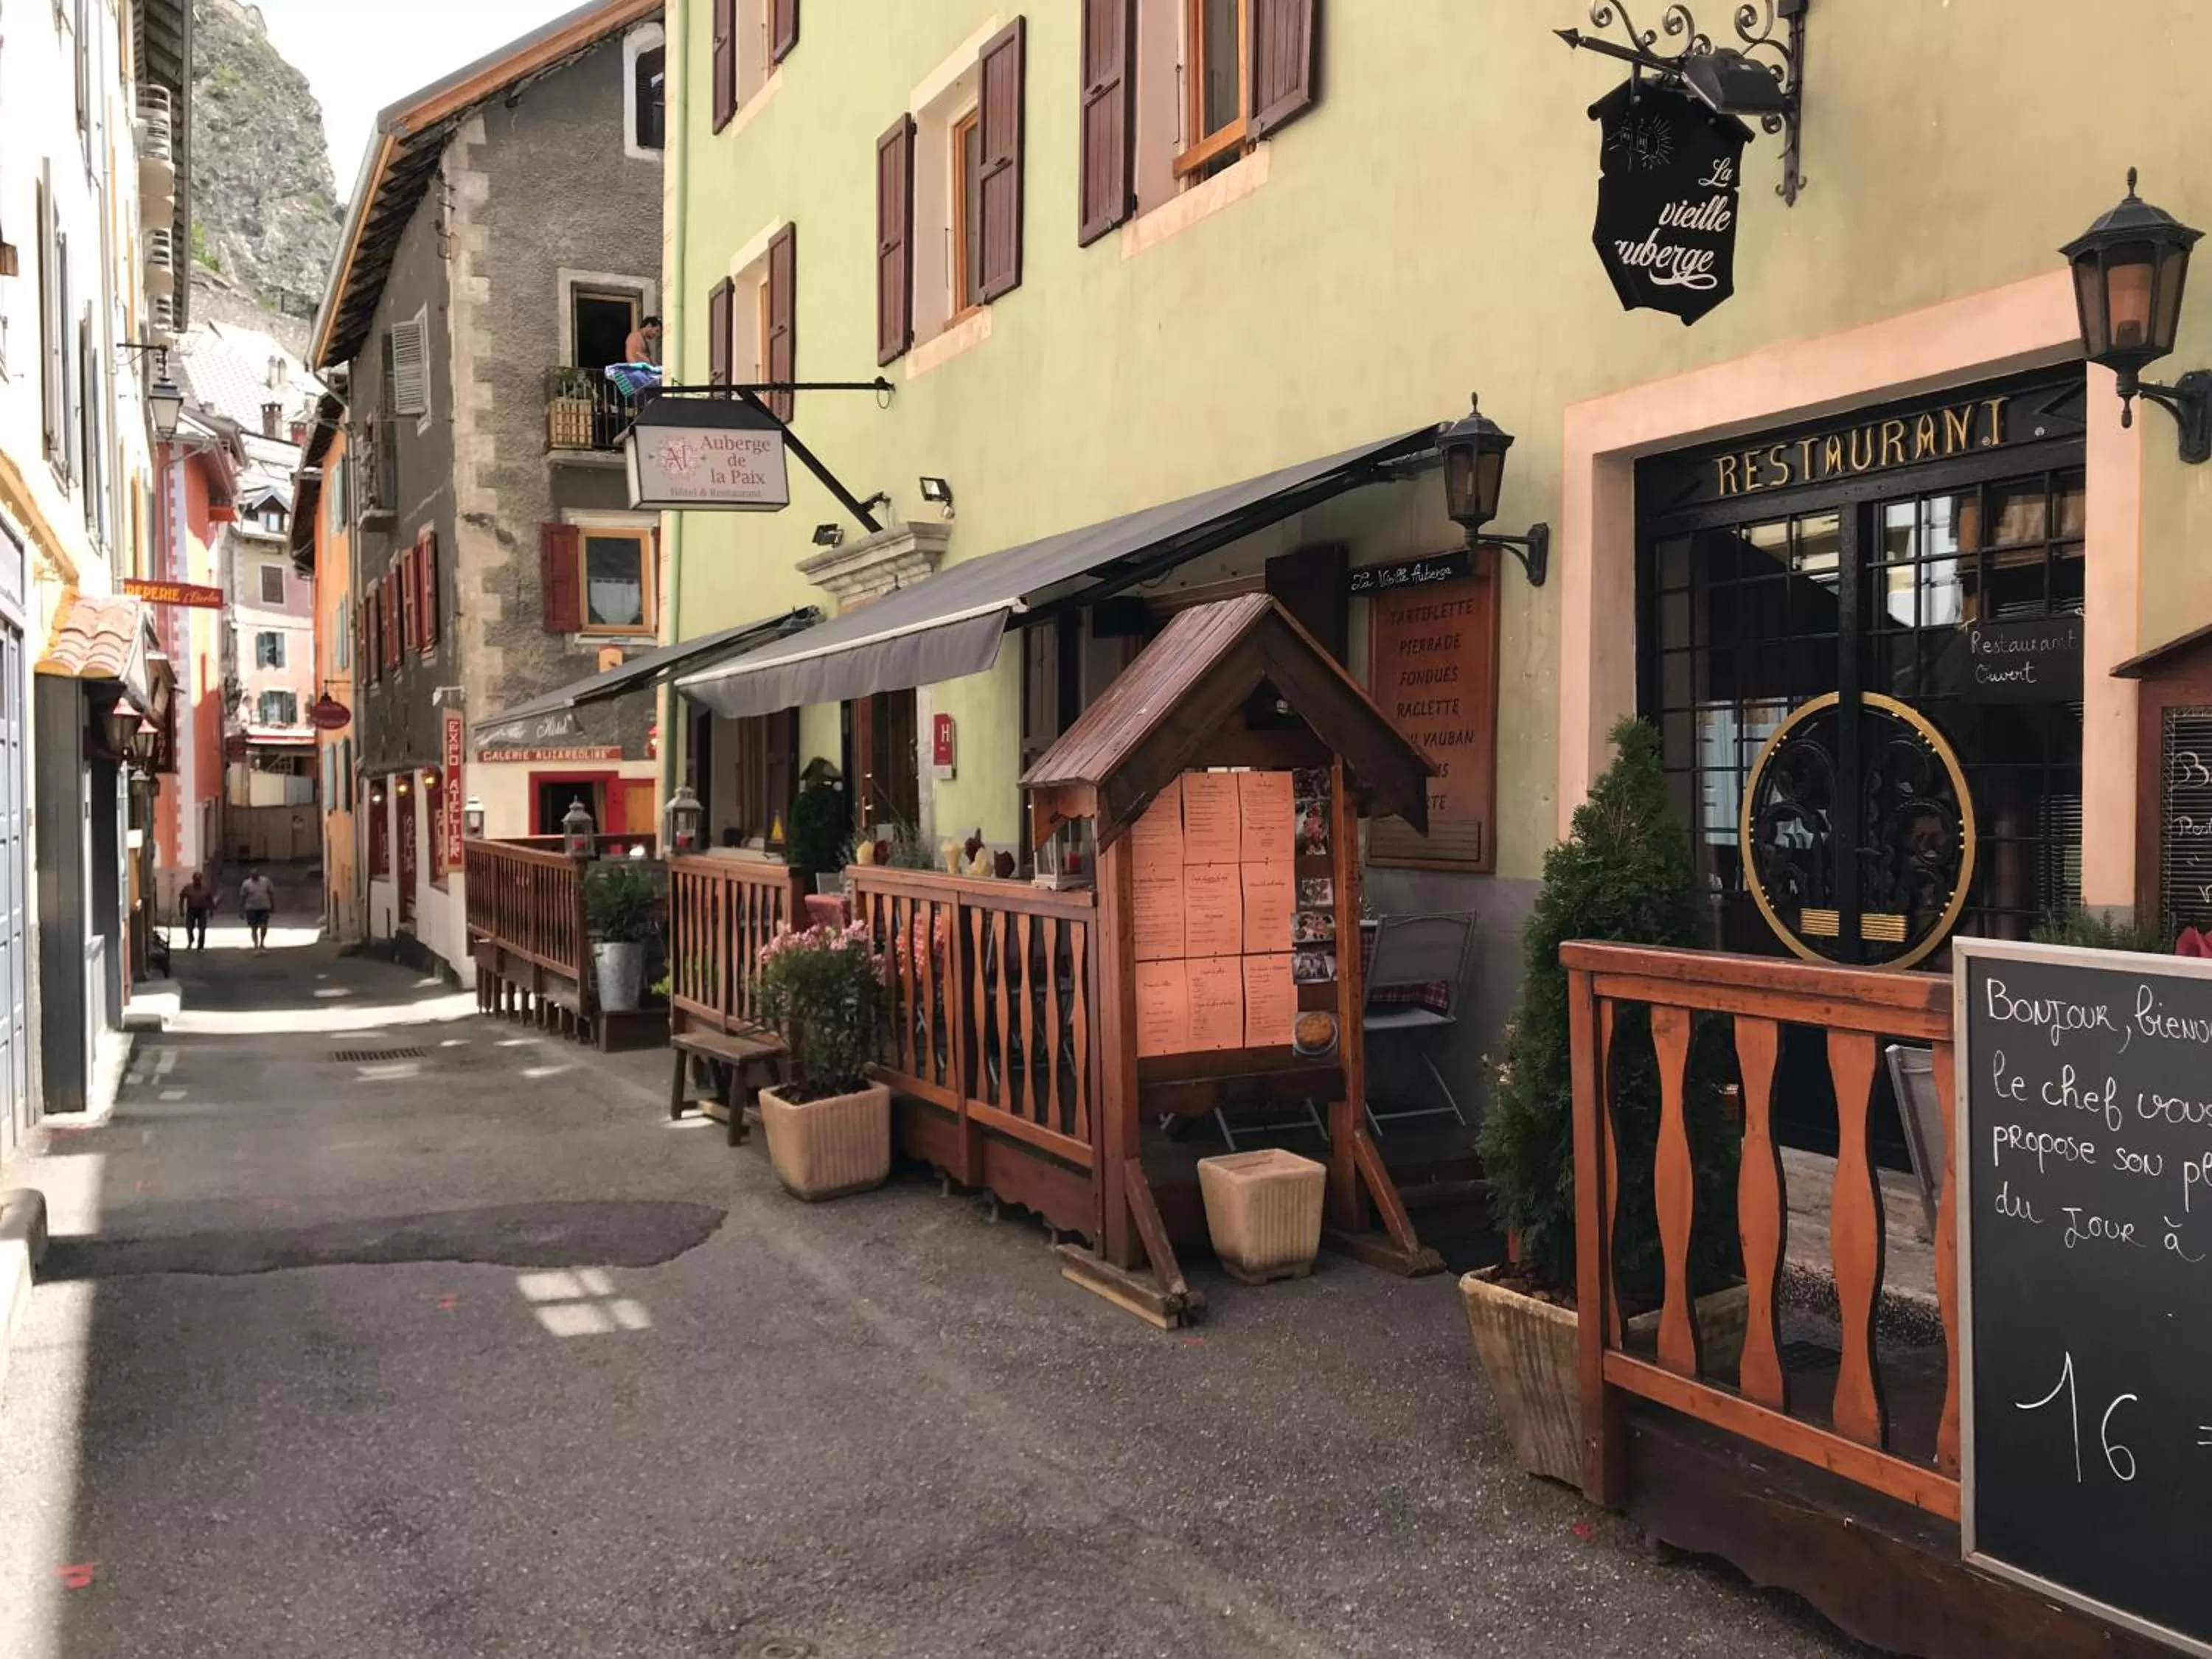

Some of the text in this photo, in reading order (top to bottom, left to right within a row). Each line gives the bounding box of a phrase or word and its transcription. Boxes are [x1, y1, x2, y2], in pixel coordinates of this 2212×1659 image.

[1698, 157, 1733, 187] La
[1658, 195, 1731, 232] vieille
[700, 435, 771, 455] Auberge
[1714, 397, 2009, 496] RESTAURANT
[727, 454, 746, 467] de
[711, 468, 766, 484] la Paix
[124, 583, 181, 602] REPERIE
[1399, 633, 1463, 655] PIERRADE
[1971, 628, 2077, 655] Restaurant
[1399, 666, 1458, 686] FONDUES
[1397, 698, 1460, 718] RACLETTE
[940, 723, 950, 742] H
[1423, 730, 1475, 747] VAUBAN
[483, 750, 530, 762] GALERIE
[448, 720, 461, 859] EXPO ATELIER
[2041, 1064, 2123, 1133] chef
[1994, 1180, 2045, 1225] du
[2014, 1350, 2138, 1484] 16
